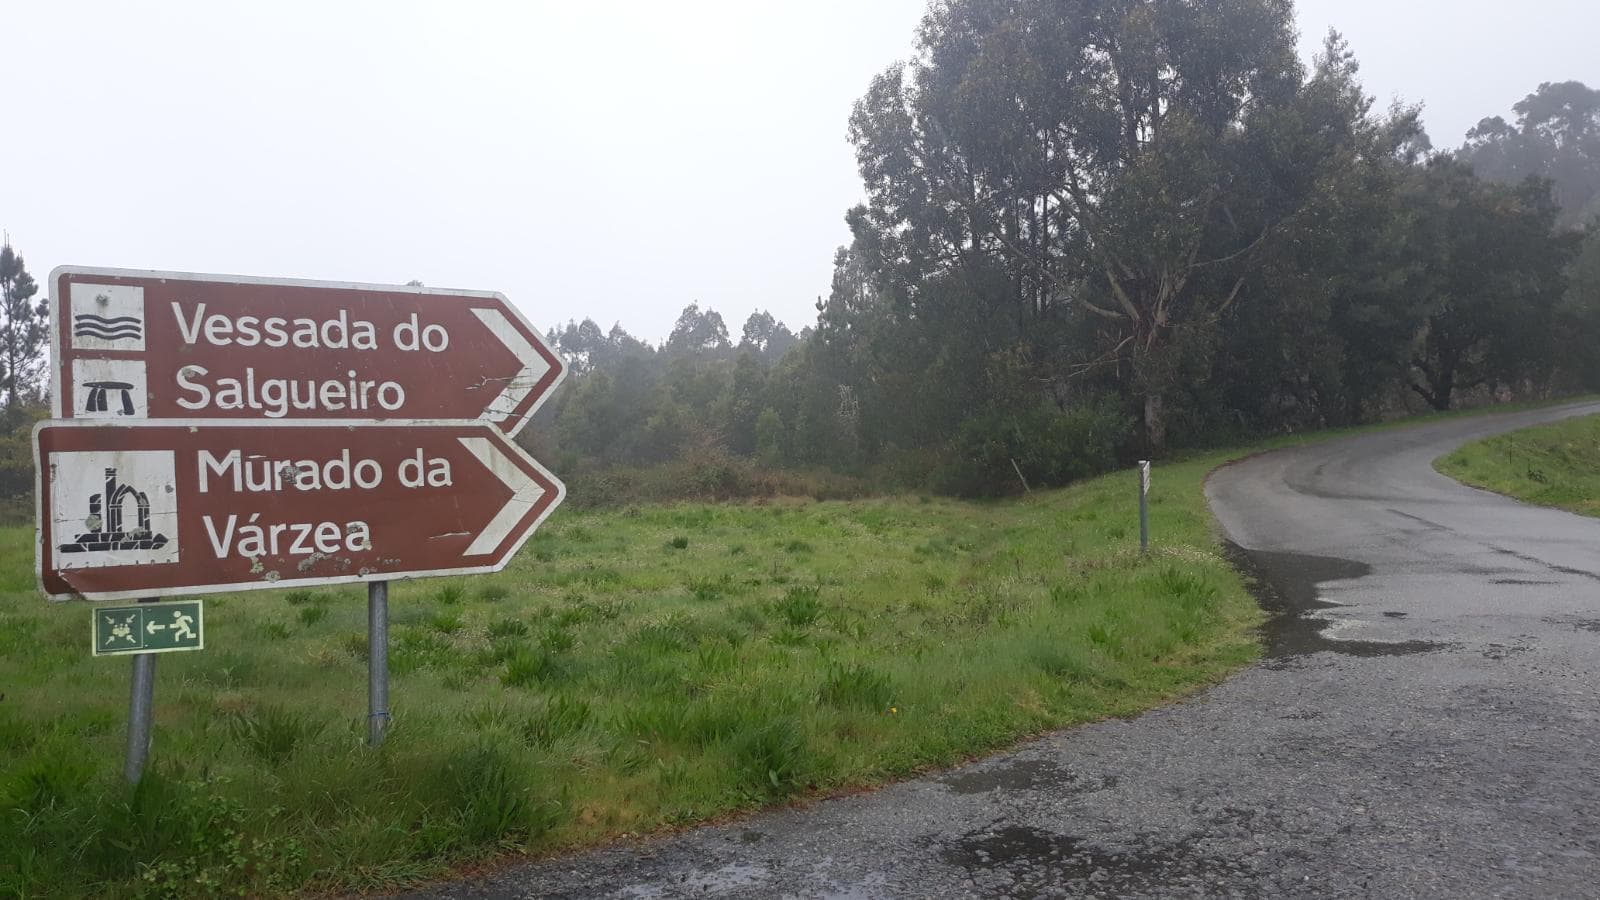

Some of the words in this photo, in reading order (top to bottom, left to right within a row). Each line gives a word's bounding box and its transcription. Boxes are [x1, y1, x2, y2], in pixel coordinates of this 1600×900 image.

[171, 302, 377, 350] Vessada
[394, 313, 449, 353] do
[176, 365, 405, 418] Salgueiro
[198, 449, 382, 491] Murado
[398, 447, 452, 488] da
[203, 513, 372, 559] Várzea
